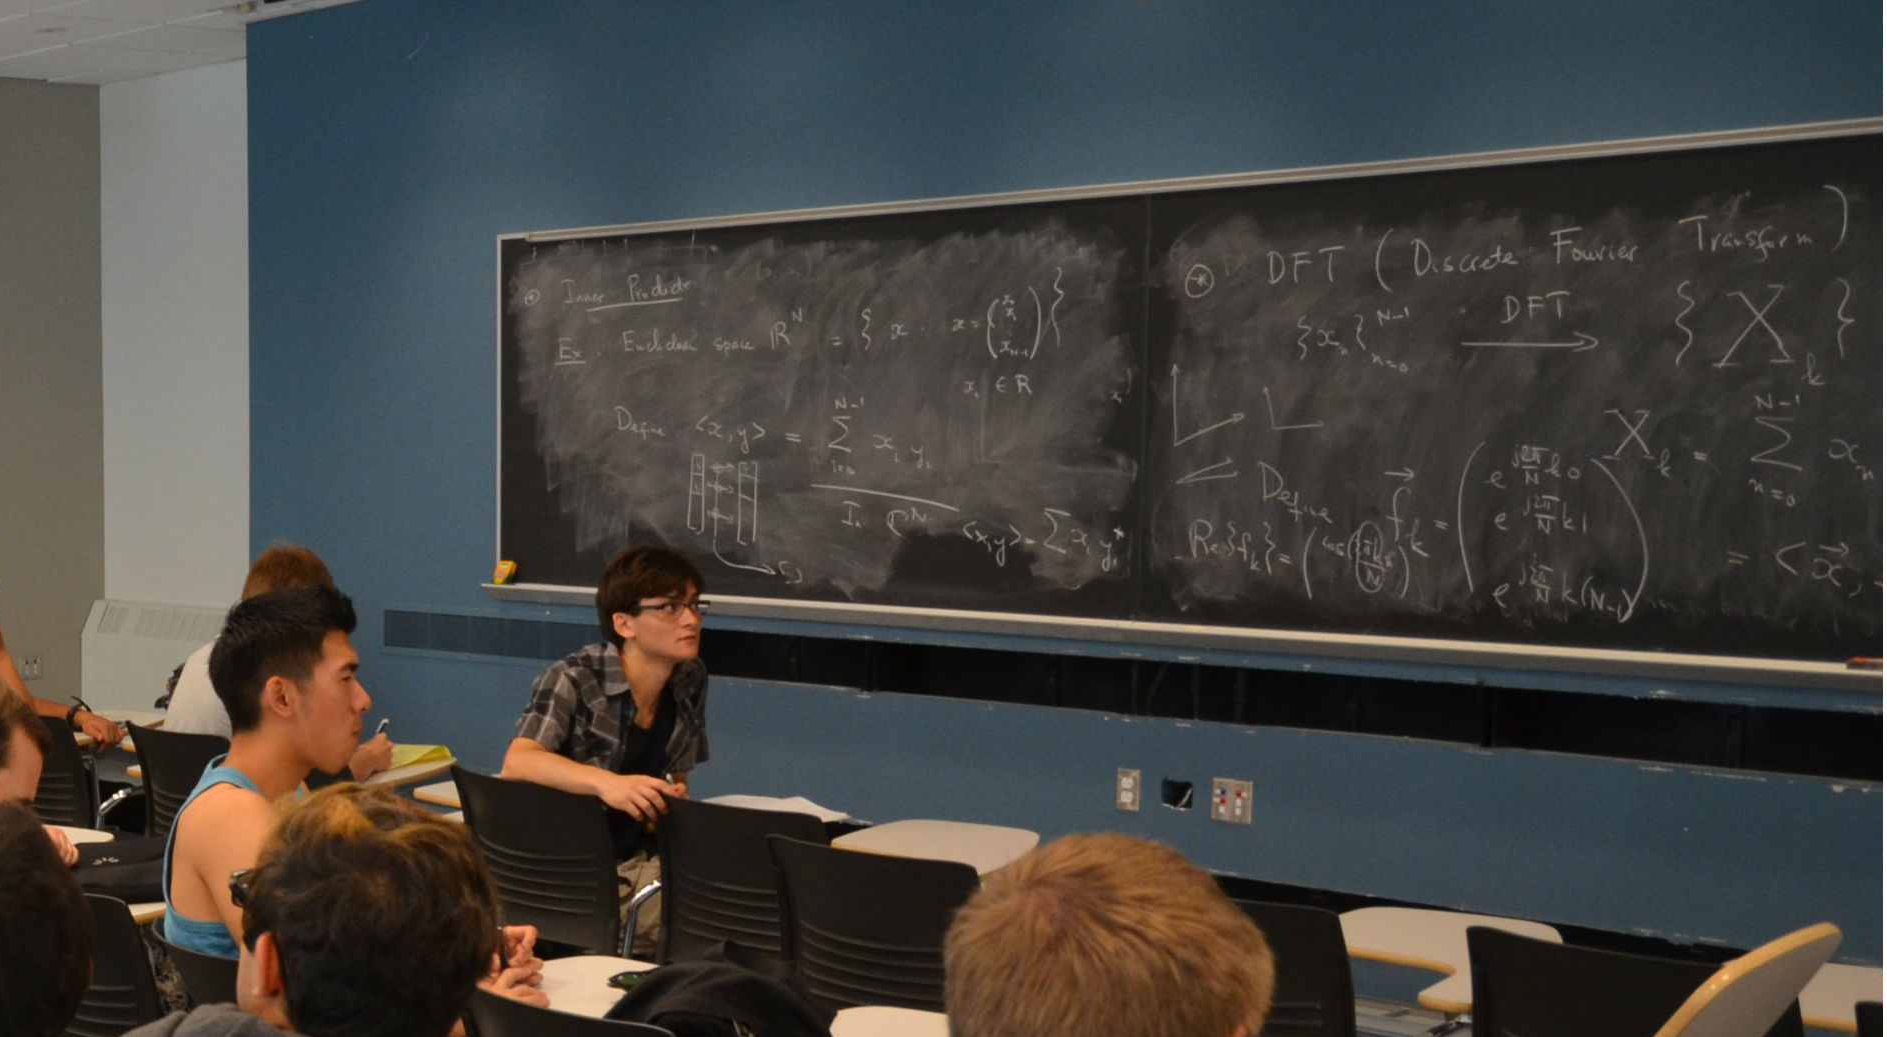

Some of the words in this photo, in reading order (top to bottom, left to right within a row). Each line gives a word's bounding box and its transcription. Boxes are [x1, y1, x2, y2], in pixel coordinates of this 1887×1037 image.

[1267, 246, 1345, 285] DFT
[1550, 226, 1638, 264] Fourier
[1501, 290, 1570, 324] DFT
